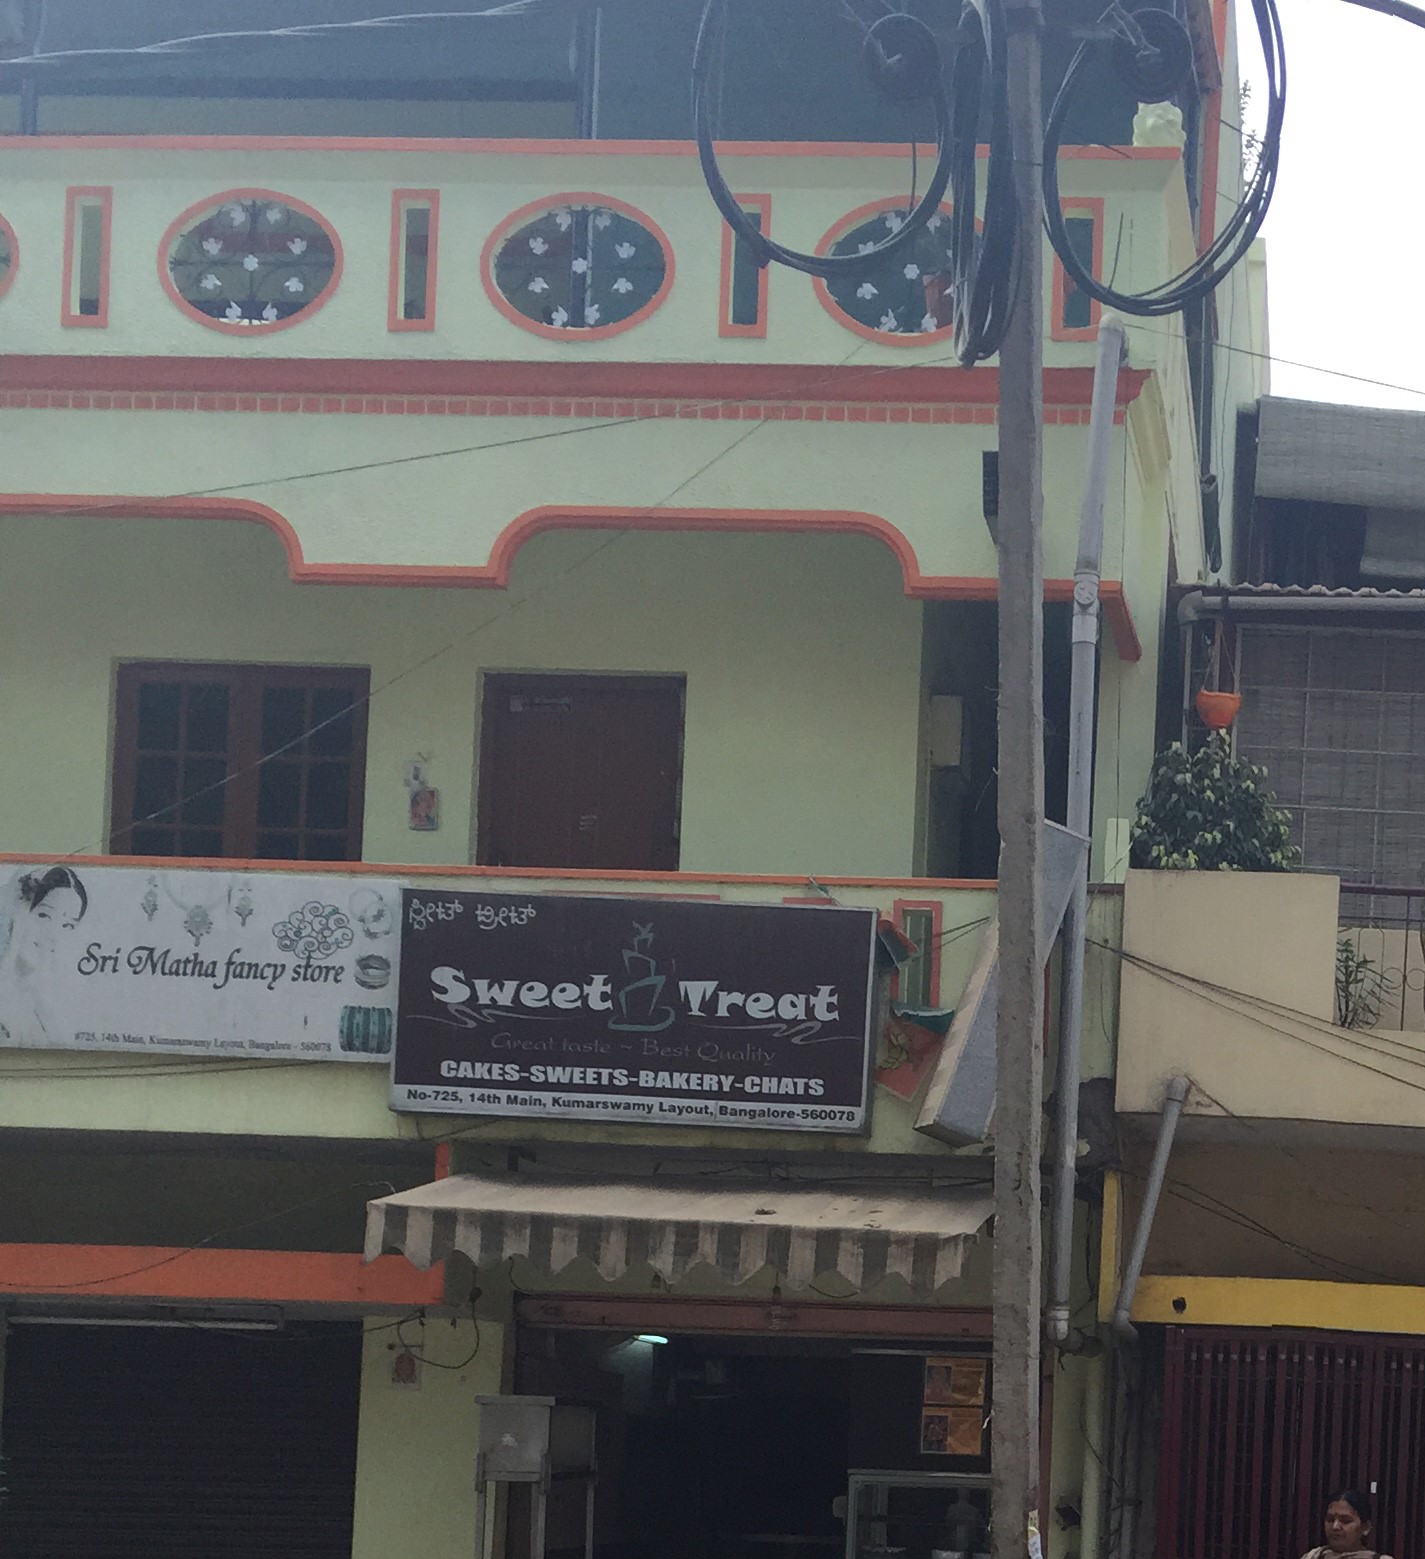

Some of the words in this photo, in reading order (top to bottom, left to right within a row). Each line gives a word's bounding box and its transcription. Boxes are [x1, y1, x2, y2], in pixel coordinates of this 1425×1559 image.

[77, 942, 121, 975] Sri
[127, 946, 217, 978] Matha
[213, 948, 286, 990] fancy
[291, 952, 345, 984] store
[430, 966, 614, 1011] Sweet
[678, 980, 840, 1022] Treat
[491, 1032, 553, 1050] Great
[641, 1038, 690, 1057] Best
[697, 1041, 776, 1067] Quality
[440, 1060, 824, 1096] CAKES-SWEETS-BAKERY-CHATS
[407, 1088, 463, 1103] No-725,
[469, 1092, 501, 1105] 14th
[506, 1095, 547, 1108] Main,
[552, 1096, 653, 1114] Kumarswamy
[658, 1101, 714, 1117] Layout,
[719, 1105, 856, 1122] Bangalore-560078
